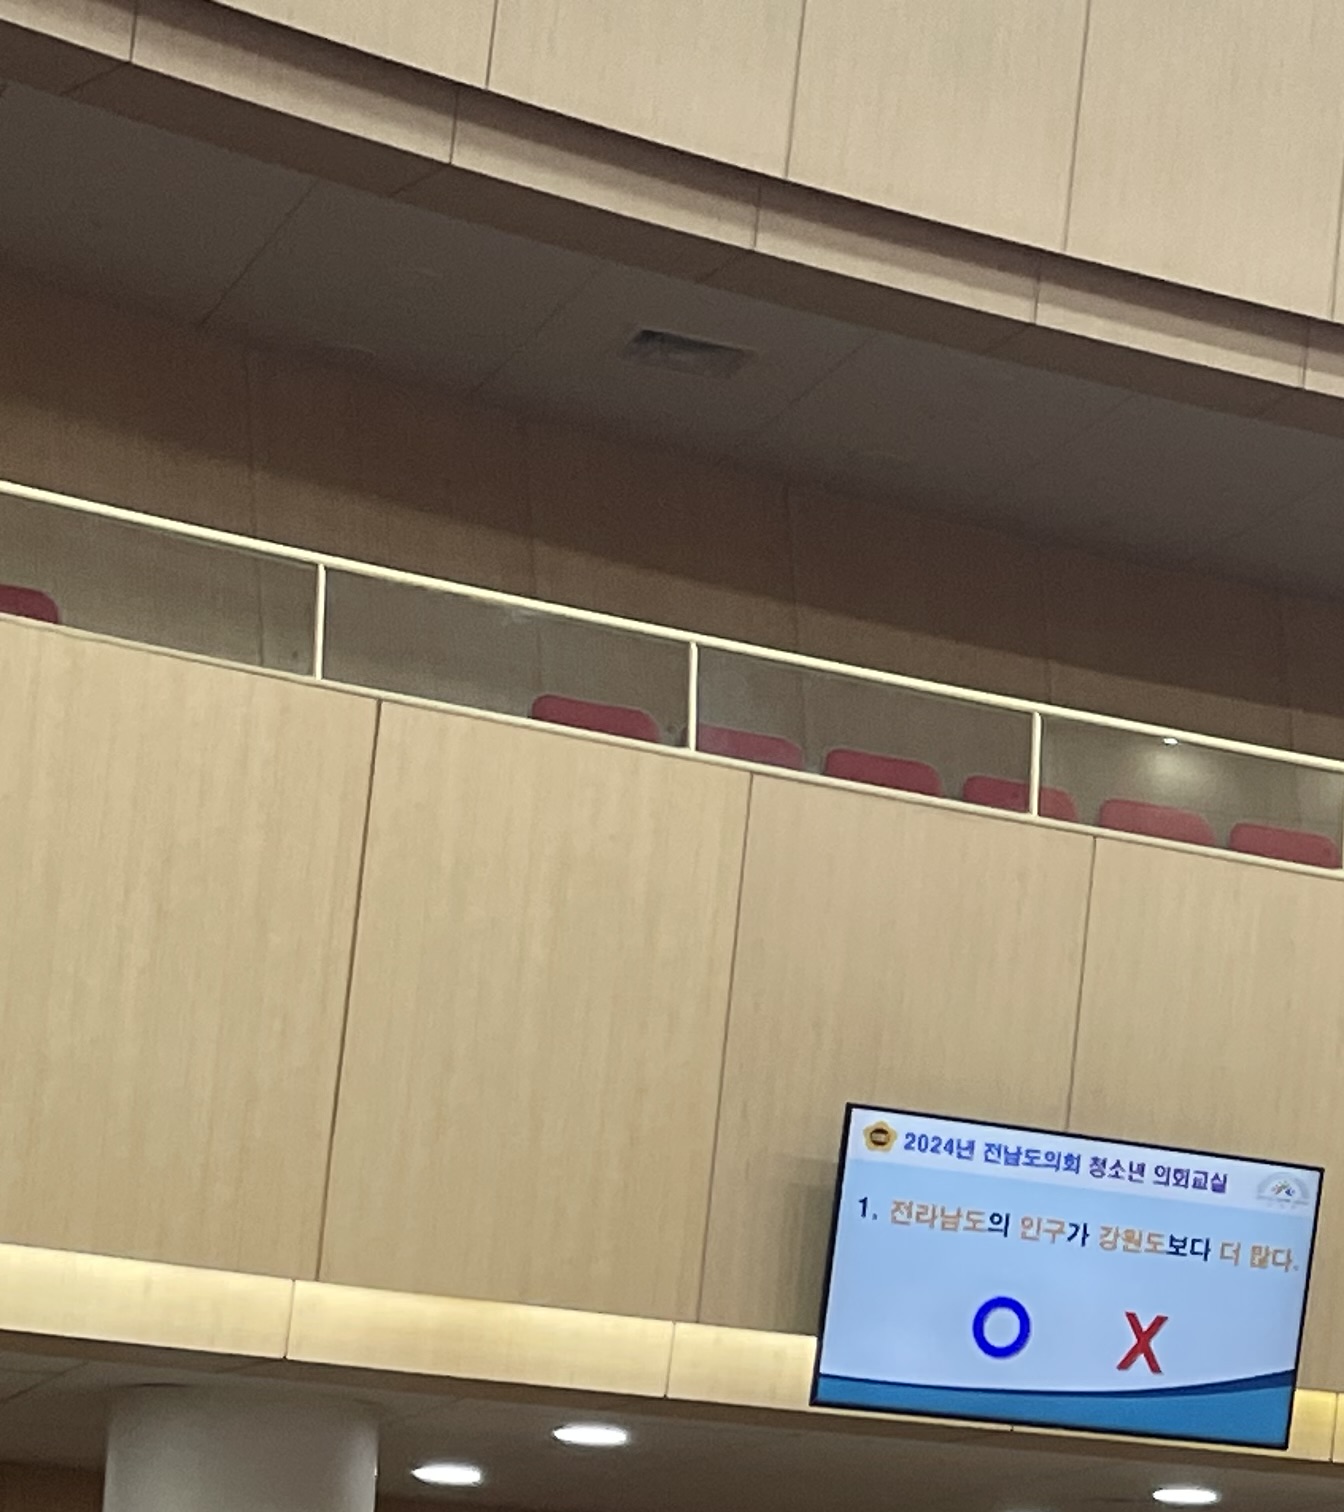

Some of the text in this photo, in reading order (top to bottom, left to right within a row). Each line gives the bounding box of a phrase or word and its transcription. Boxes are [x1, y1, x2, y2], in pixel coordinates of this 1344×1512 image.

[903, 1131, 975, 1161] 2024년
[984, 1142, 1081, 1175] 전남도의회
[1089, 1155, 1146, 1184] 청소년
[1153, 1166, 1228, 1195] 의회교실
[858, 1197, 1300, 1274] 1. 전라남도의 인구가 강원도보다 더 많다.
[972, 1296, 1169, 1375] O X
